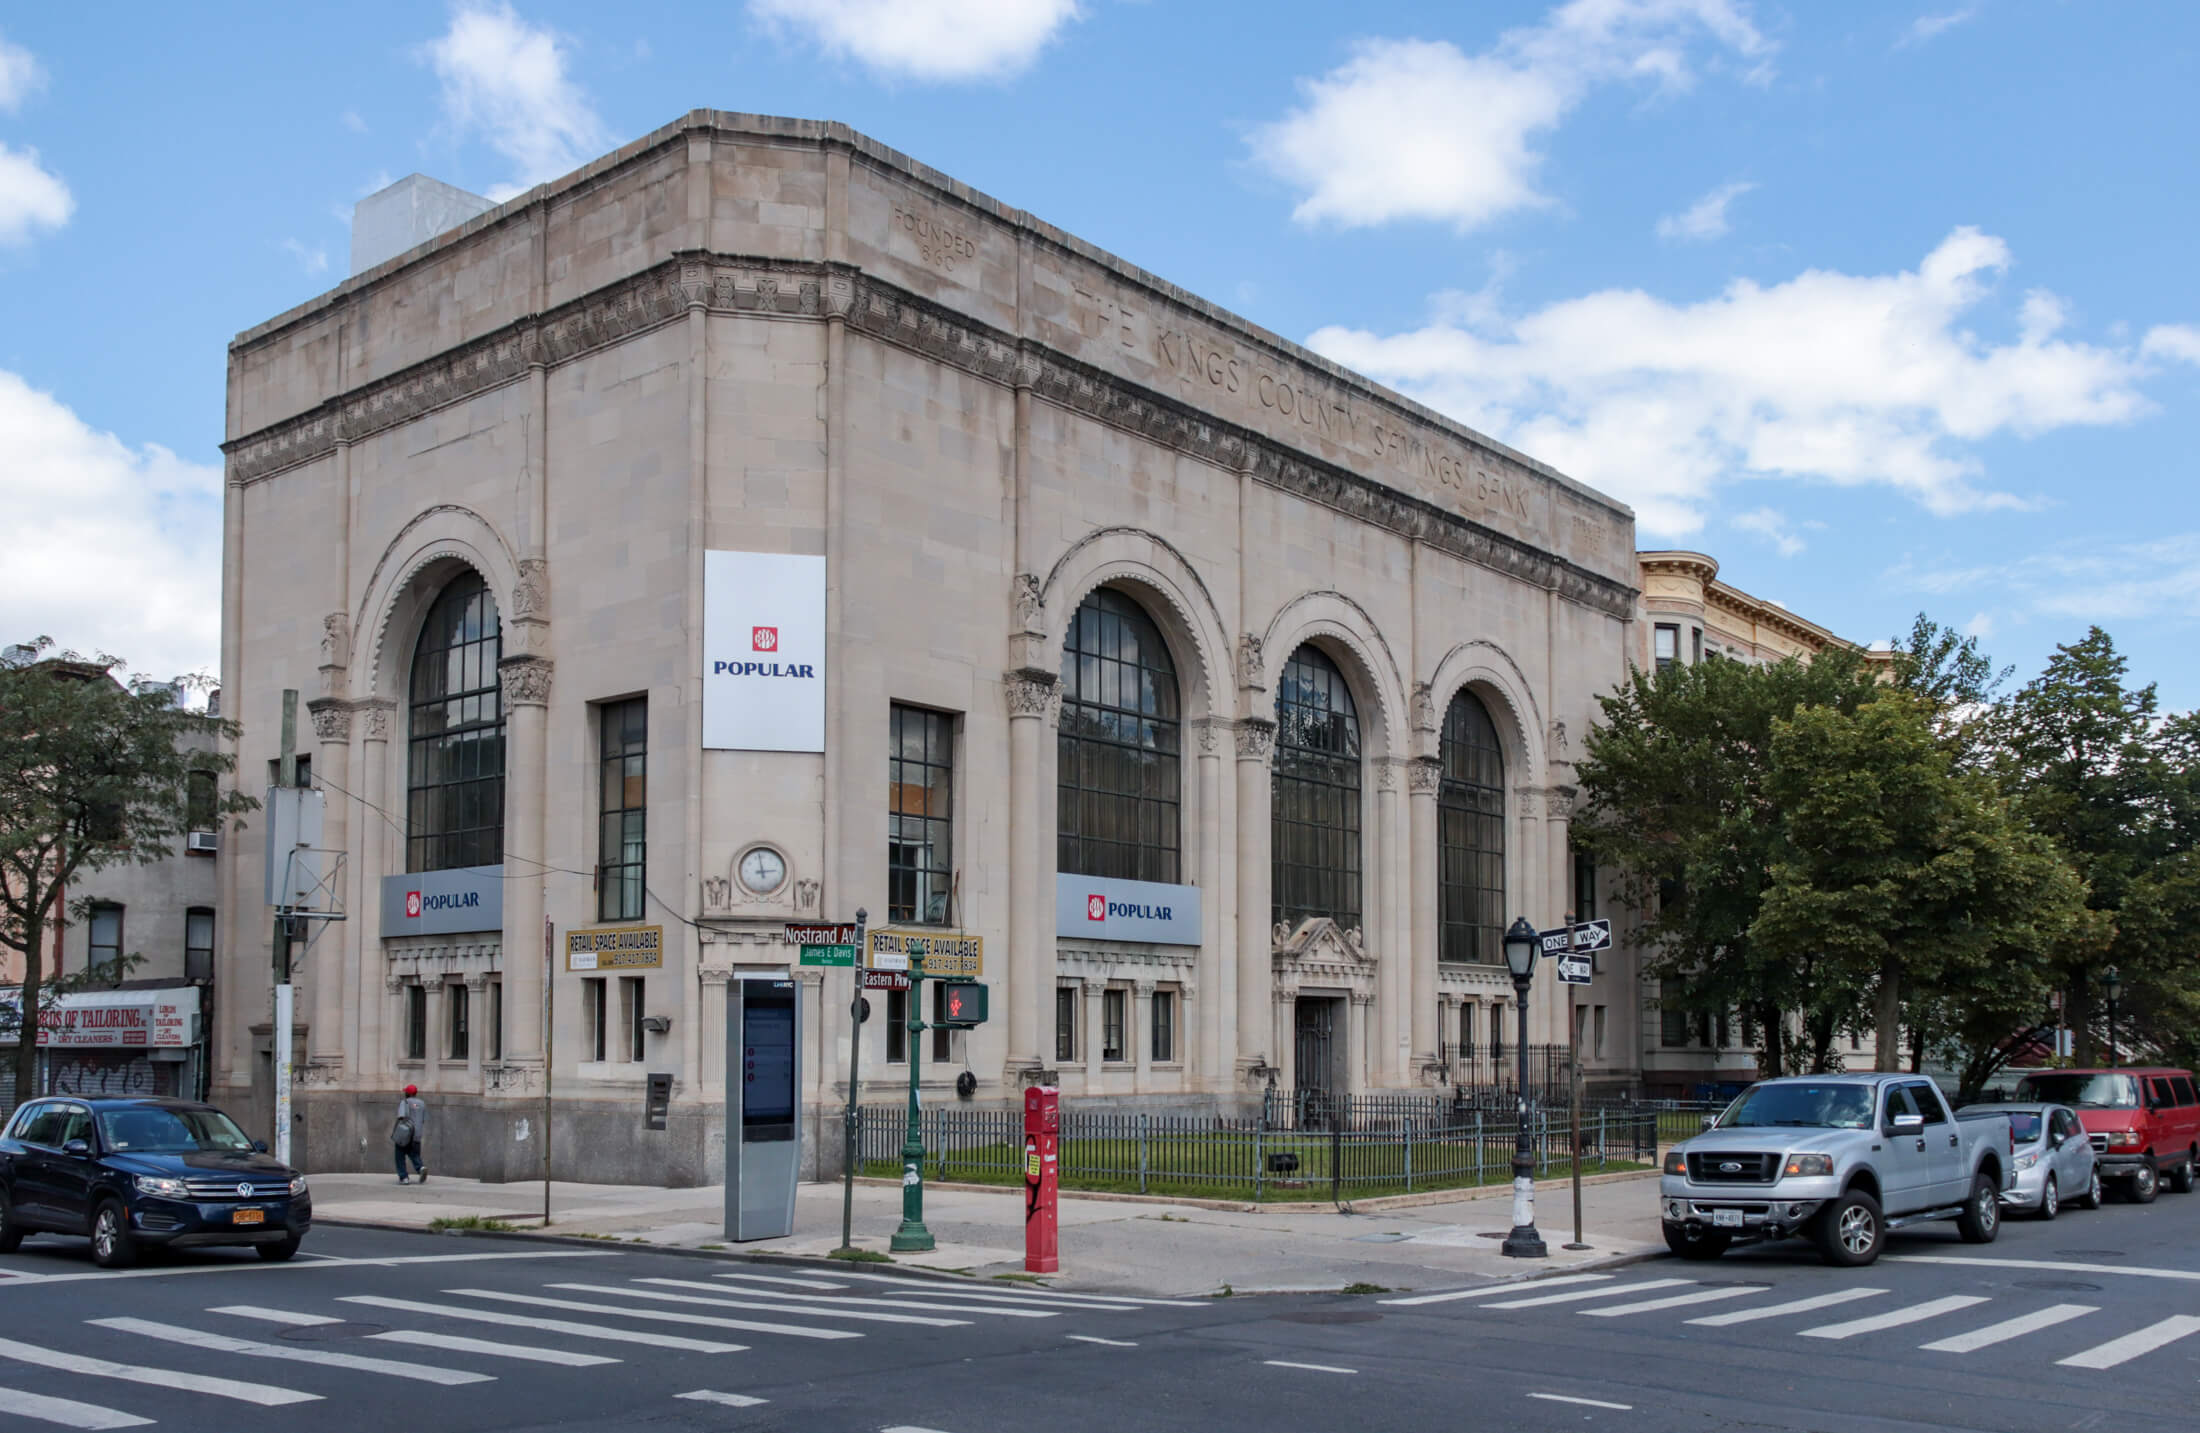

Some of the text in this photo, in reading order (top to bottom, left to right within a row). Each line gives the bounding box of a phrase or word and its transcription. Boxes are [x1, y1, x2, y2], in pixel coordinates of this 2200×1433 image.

[894, 208, 976, 258] FOUNDED
[1073, 284, 1529, 519] THE KINGS COUNTY SAVINGS BANK
[714, 660, 815, 679] POPULAR
[423, 891, 479, 911] POPULAR
[1108, 902, 1173, 921] POPULAR
[570, 931, 658, 953] RETAIL SPACE AVAILABLE
[785, 927, 838, 944] Nostrand
[1545, 929, 1601, 949] ONE WAY
[804, 946, 852, 958] James E Davis
[873, 935, 902, 953] RETAIL
[933, 939, 978, 957] AVAILABLE
[865, 972, 893, 986] Eastern
[65, 1009, 78, 1028] OF
[81, 1008, 140, 1029] TAILORING
[74, 1034, 113, 1044] CLEANERS
